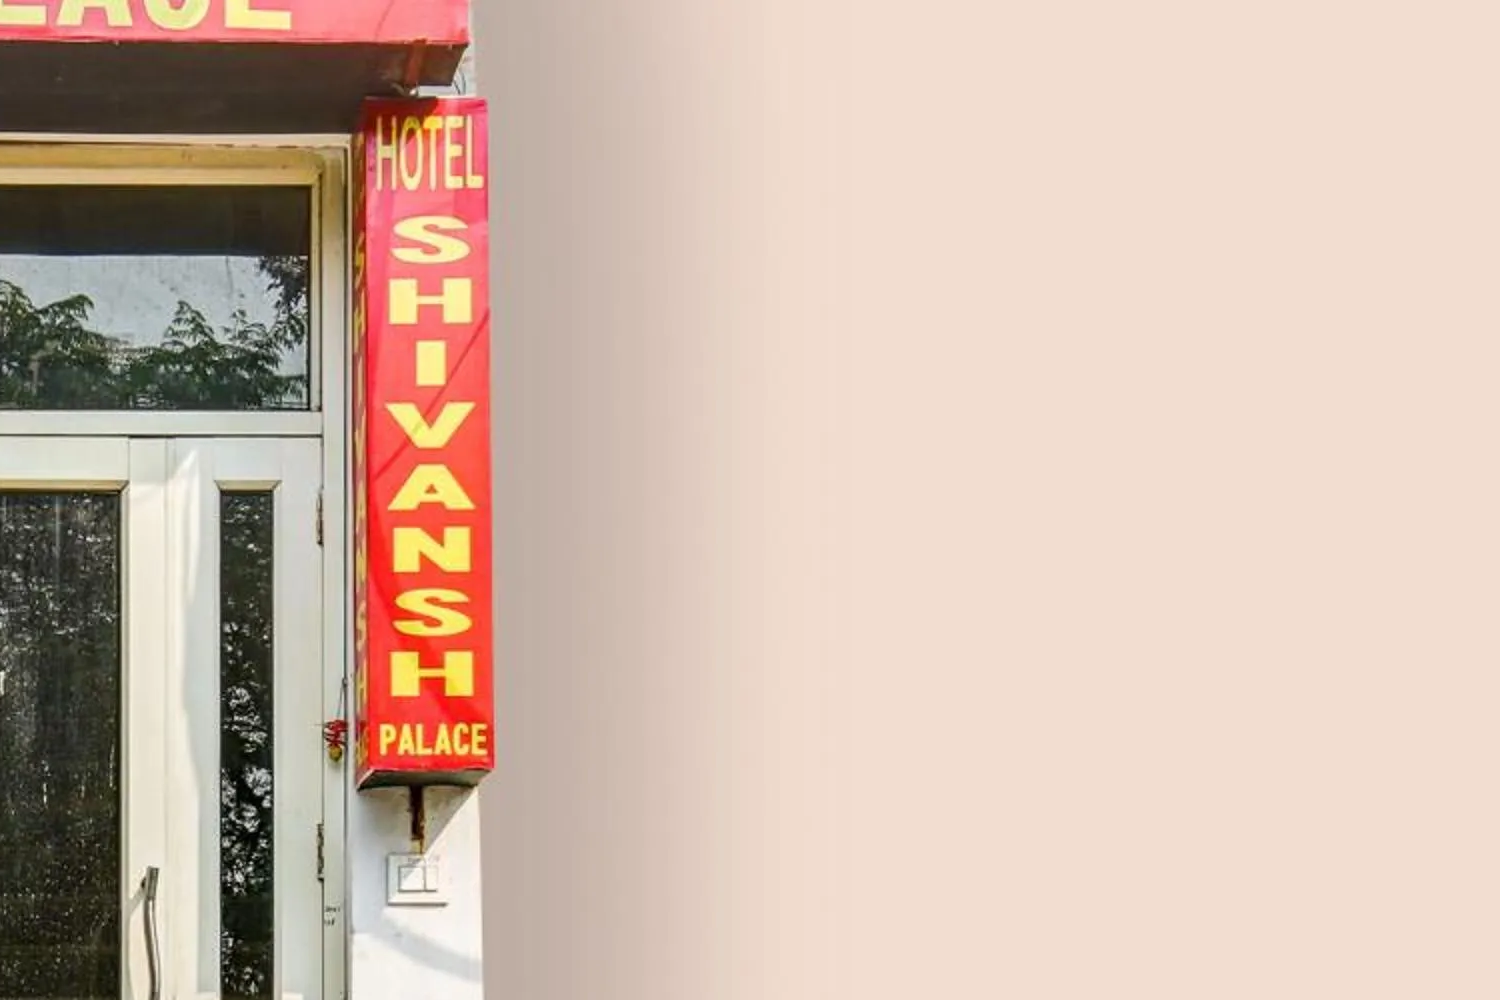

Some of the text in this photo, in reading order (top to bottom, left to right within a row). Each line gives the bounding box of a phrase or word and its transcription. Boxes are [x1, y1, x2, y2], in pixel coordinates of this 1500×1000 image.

[375, 115, 484, 191] HOTEL
[384, 215, 477, 697] SHIVANSH
[379, 723, 488, 756] PALACE
